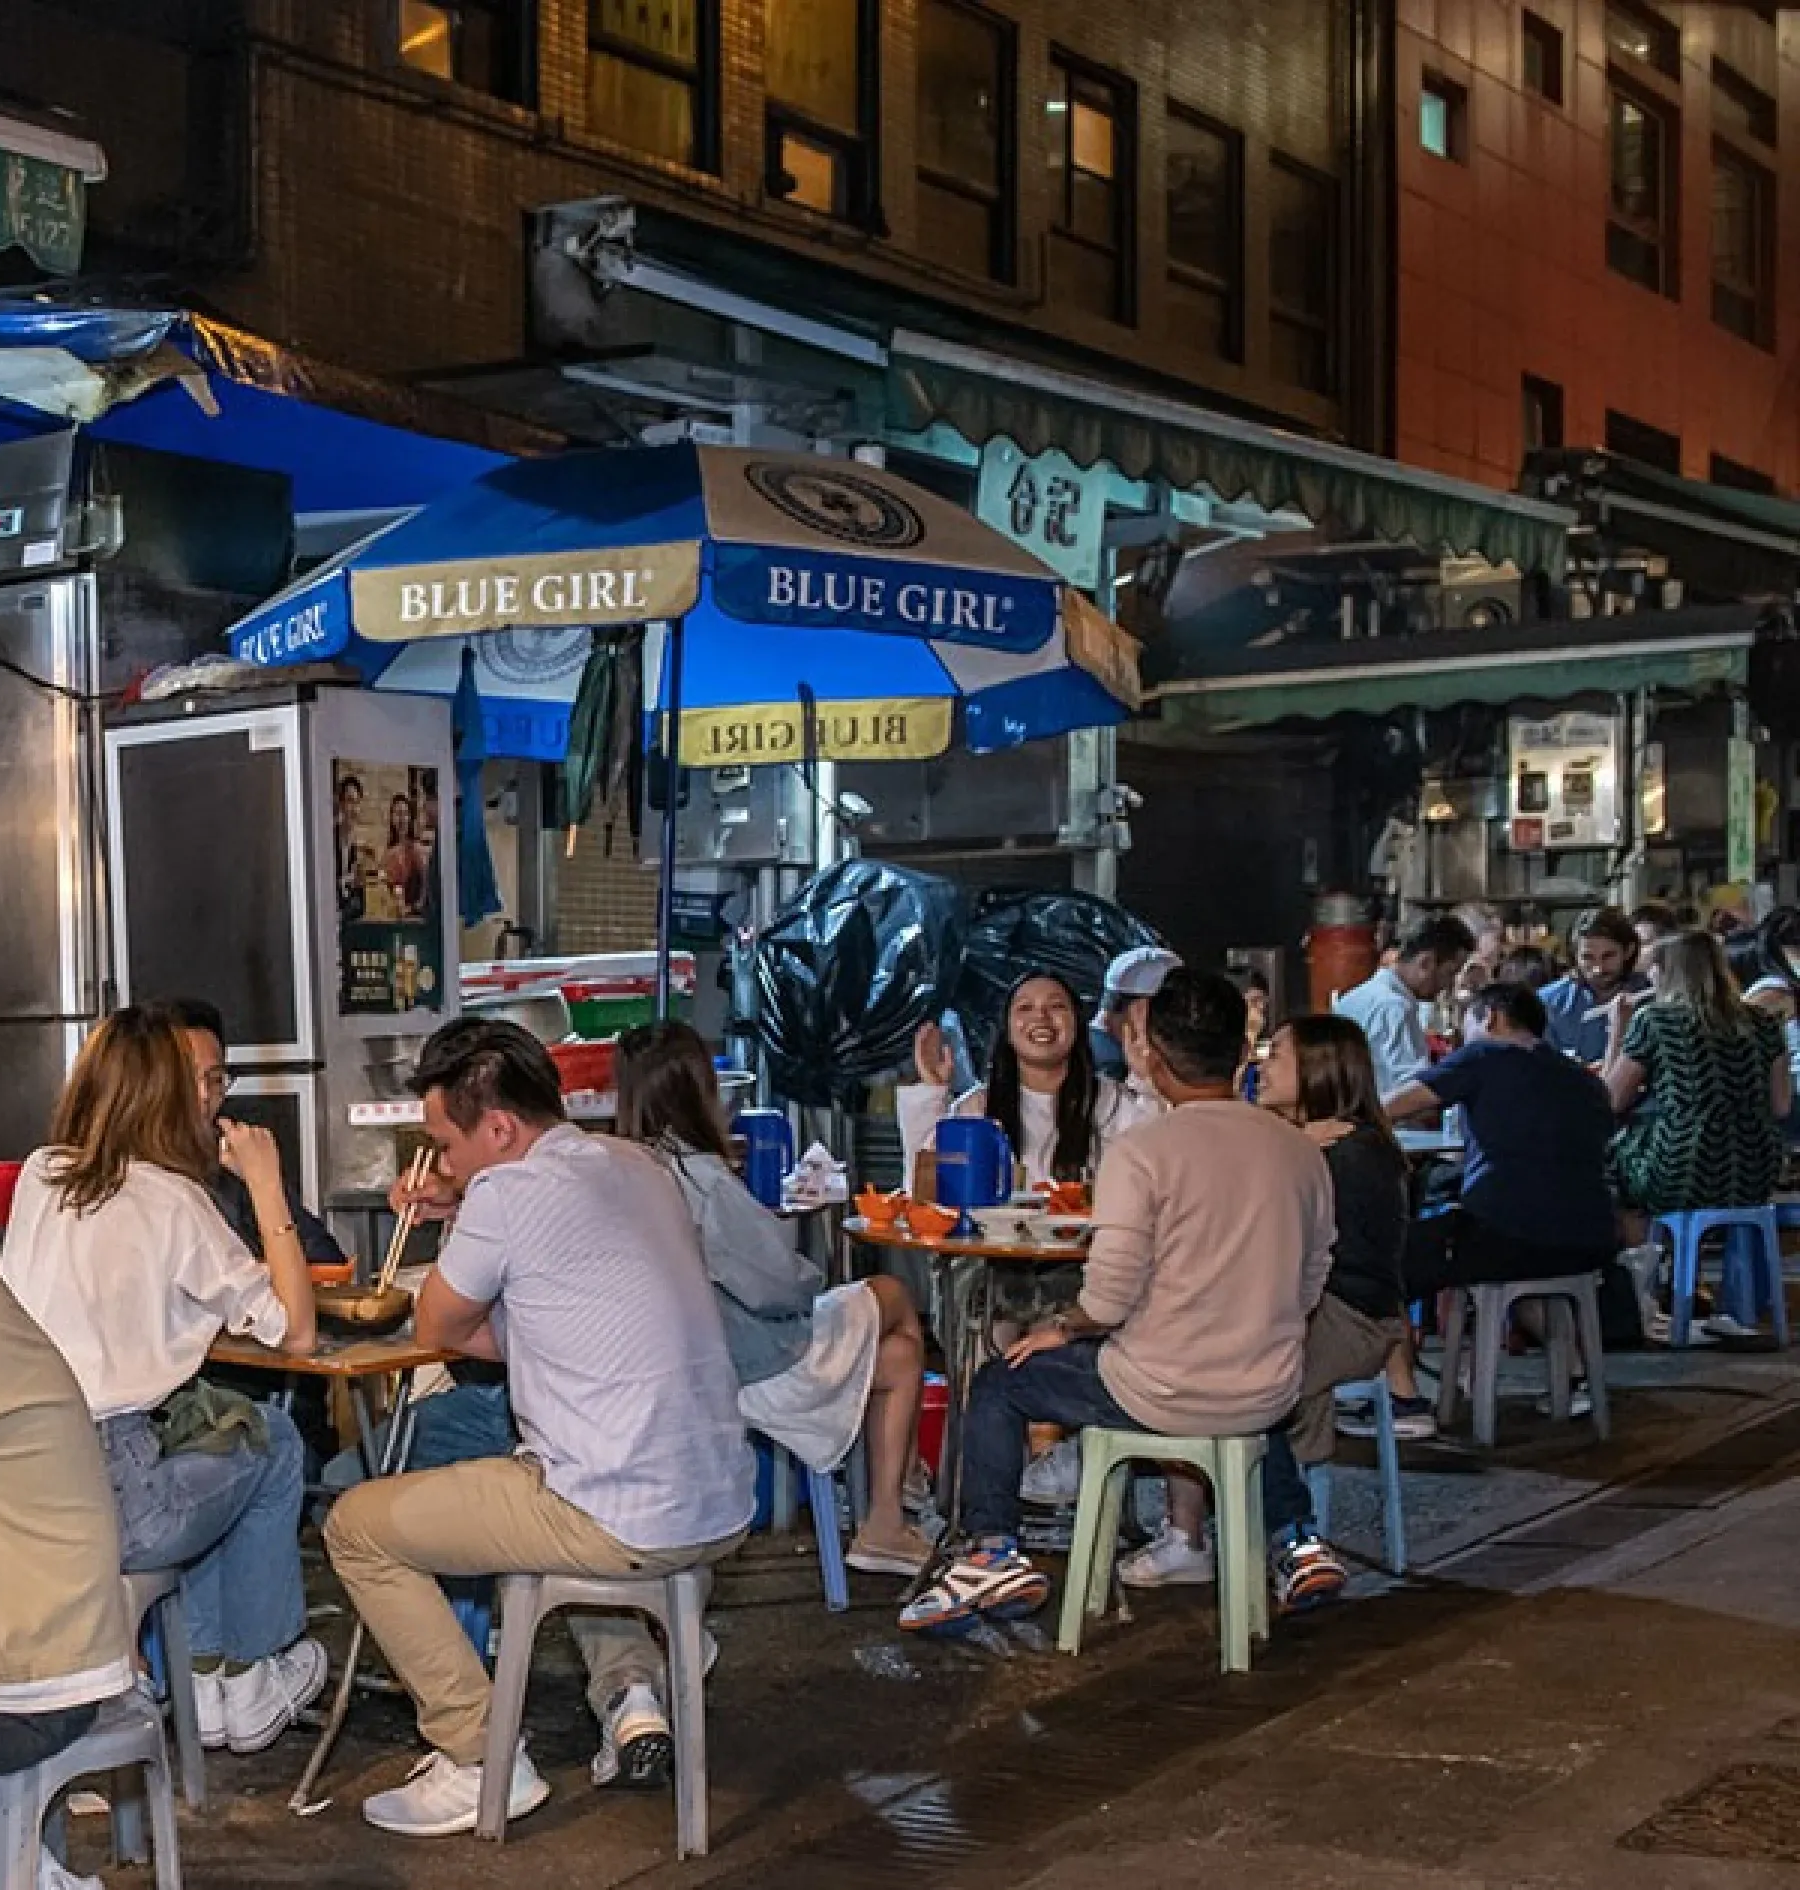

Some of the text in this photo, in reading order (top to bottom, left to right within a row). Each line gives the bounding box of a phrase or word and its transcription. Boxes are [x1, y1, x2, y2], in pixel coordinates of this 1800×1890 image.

[400, 569, 648, 622] BLUE GIRL
[766, 565, 1007, 634] BLUE GIRL
